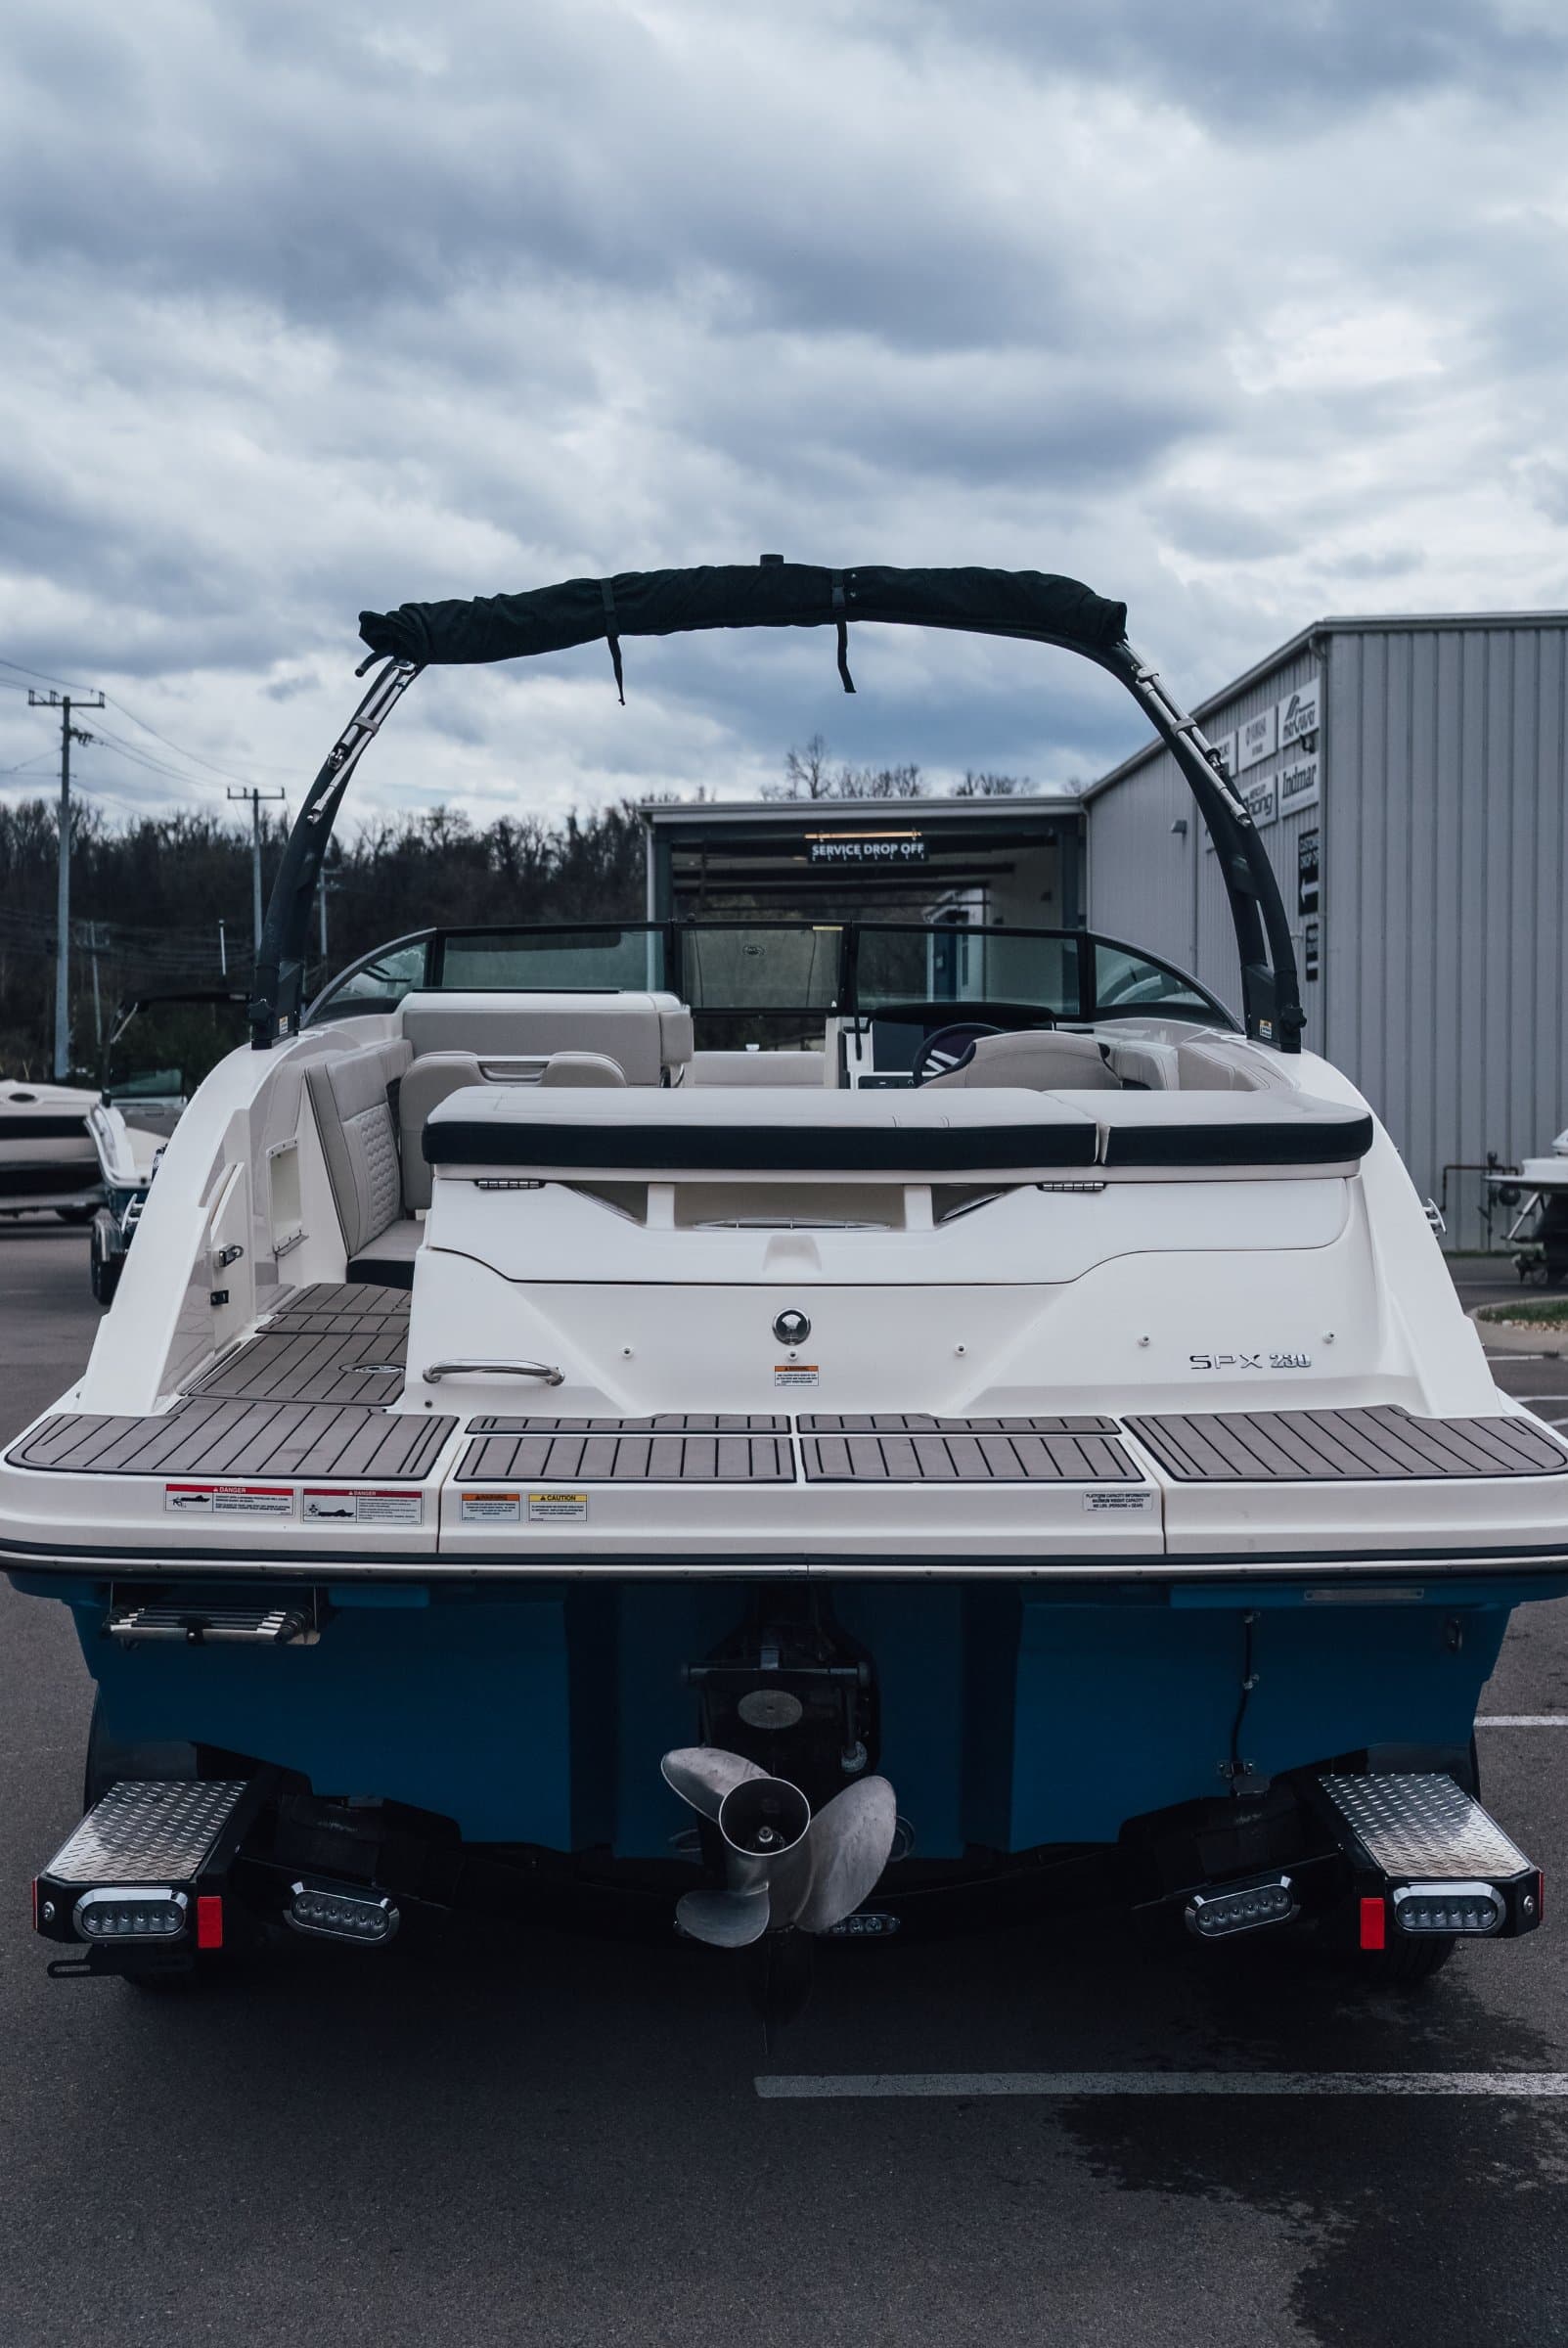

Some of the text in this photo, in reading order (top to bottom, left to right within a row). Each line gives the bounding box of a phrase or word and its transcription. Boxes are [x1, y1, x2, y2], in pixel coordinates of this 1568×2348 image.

[1282, 763, 1316, 798] Indmar
[812, 842, 924, 856] SERVICE DROP OFF
[1189, 1353, 1312, 1370] SPX 230
